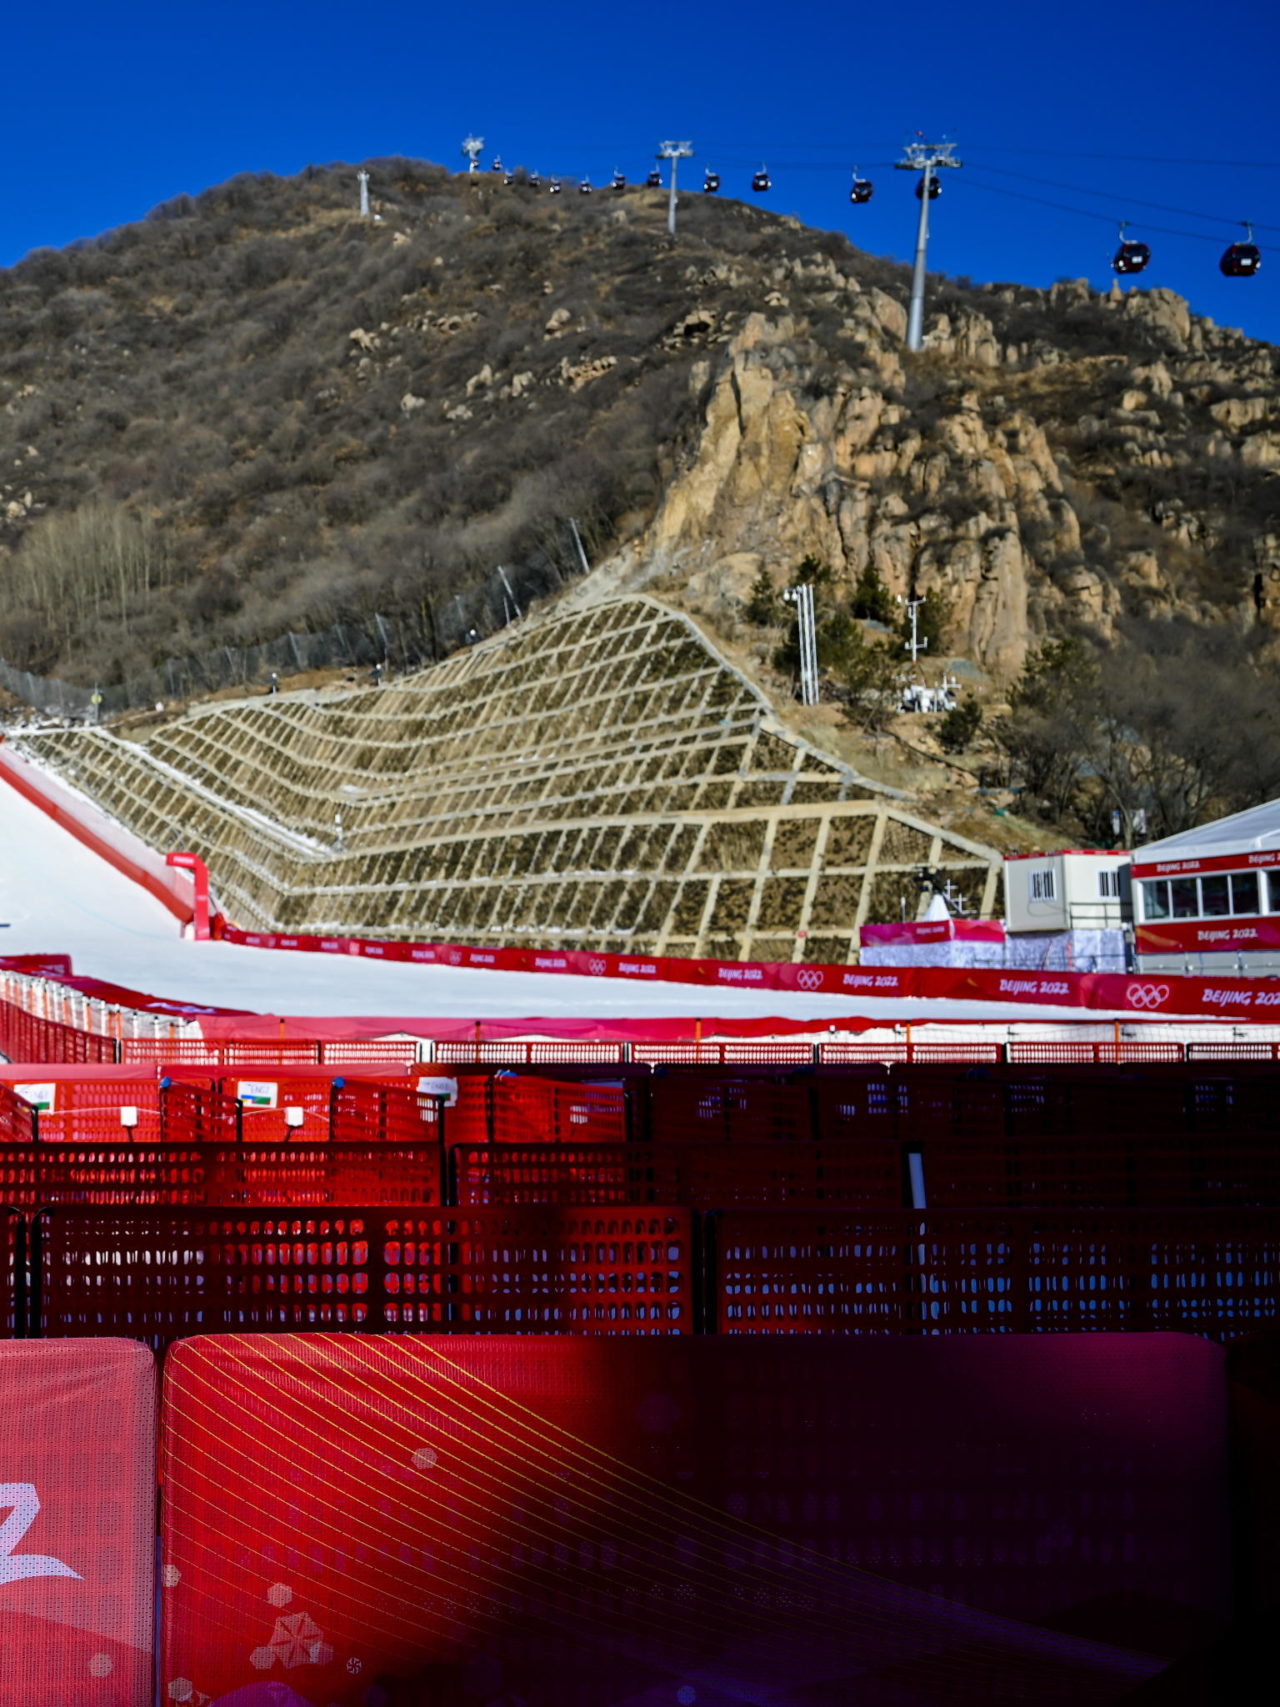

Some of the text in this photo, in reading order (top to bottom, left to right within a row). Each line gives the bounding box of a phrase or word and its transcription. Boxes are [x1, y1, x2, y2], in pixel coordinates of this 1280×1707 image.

[1197, 928, 1258, 943] BEIJING 2022
[842, 973, 899, 988] BEIJING 2022
[999, 979, 1070, 996] BEIJING 2022
[1201, 988, 1280, 1007] BEIJING 202
